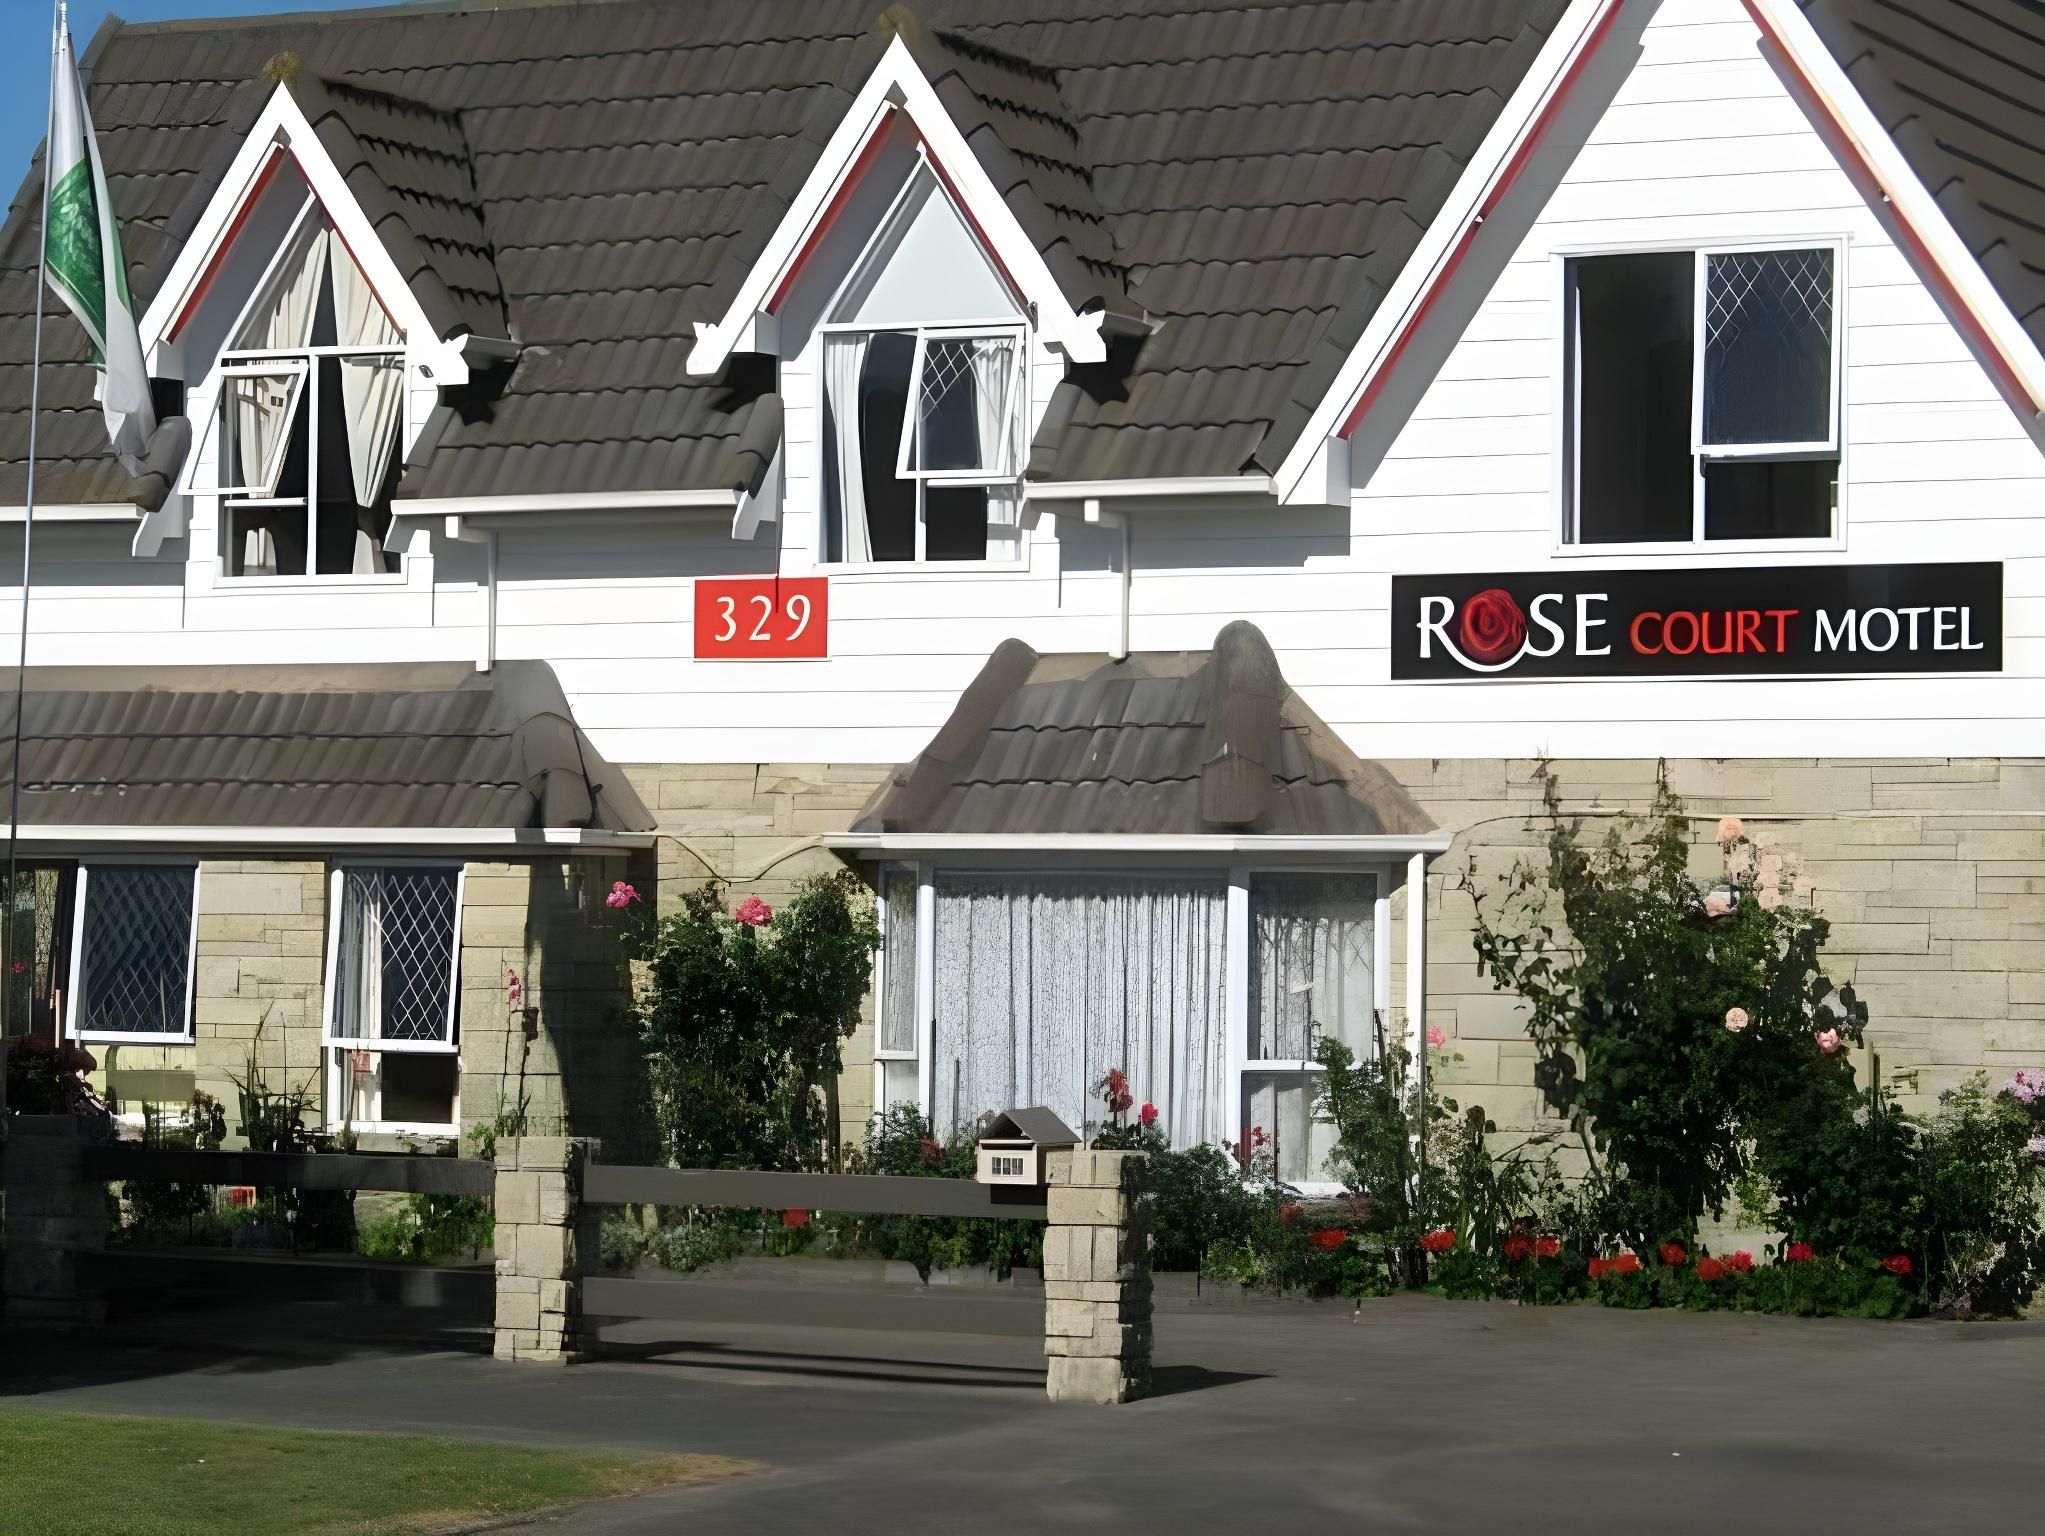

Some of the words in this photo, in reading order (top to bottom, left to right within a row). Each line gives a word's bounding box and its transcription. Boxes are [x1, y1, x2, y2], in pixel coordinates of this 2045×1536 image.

[714, 594, 811, 642] 329
[1416, 588, 1612, 673] ROSE
[1629, 609, 1799, 655] COURT
[1814, 606, 1984, 653] MOTEL
